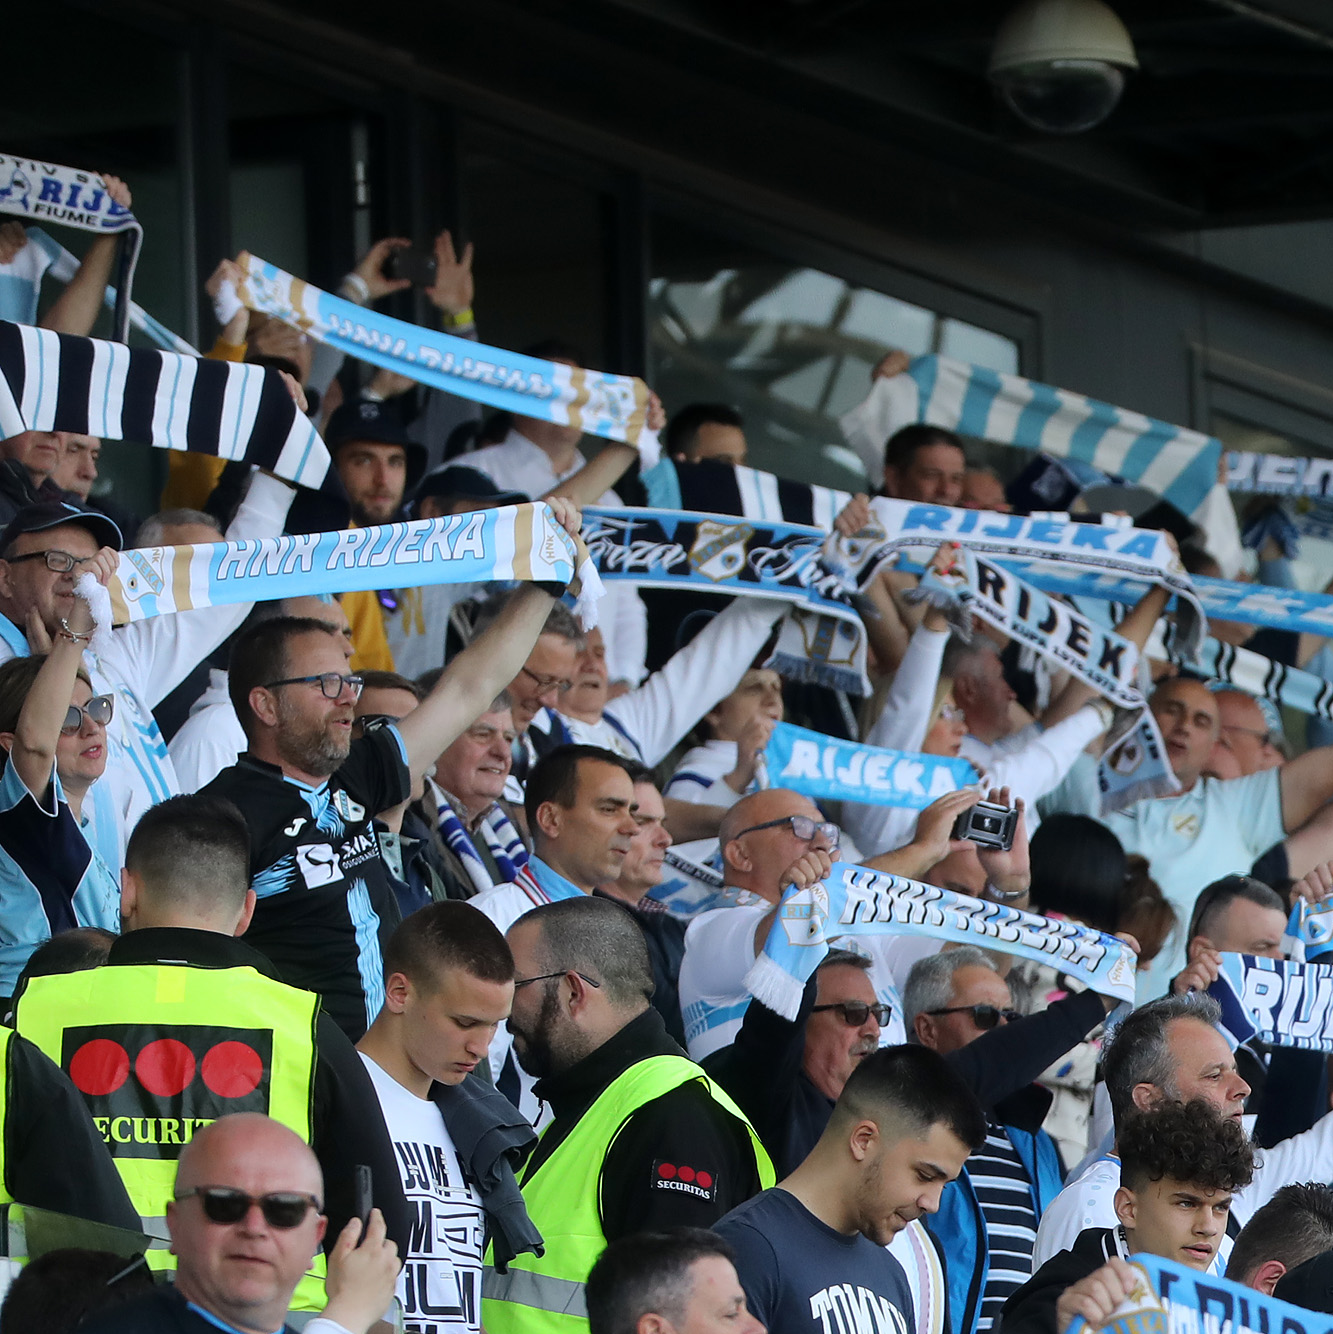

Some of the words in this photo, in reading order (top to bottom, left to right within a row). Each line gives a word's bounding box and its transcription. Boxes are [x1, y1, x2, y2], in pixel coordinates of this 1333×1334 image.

[33, 203, 98, 227] FIUME
[217, 534, 319, 581] HNK
[326, 512, 487, 570] RIJEKA
[901, 505, 1161, 560] RIJEKA
[150, 547, 162, 565] NK
[780, 739, 957, 797] RIJEKA
[91, 1116, 218, 1145] ECURI
[656, 1180, 711, 1200] SECURITAS
